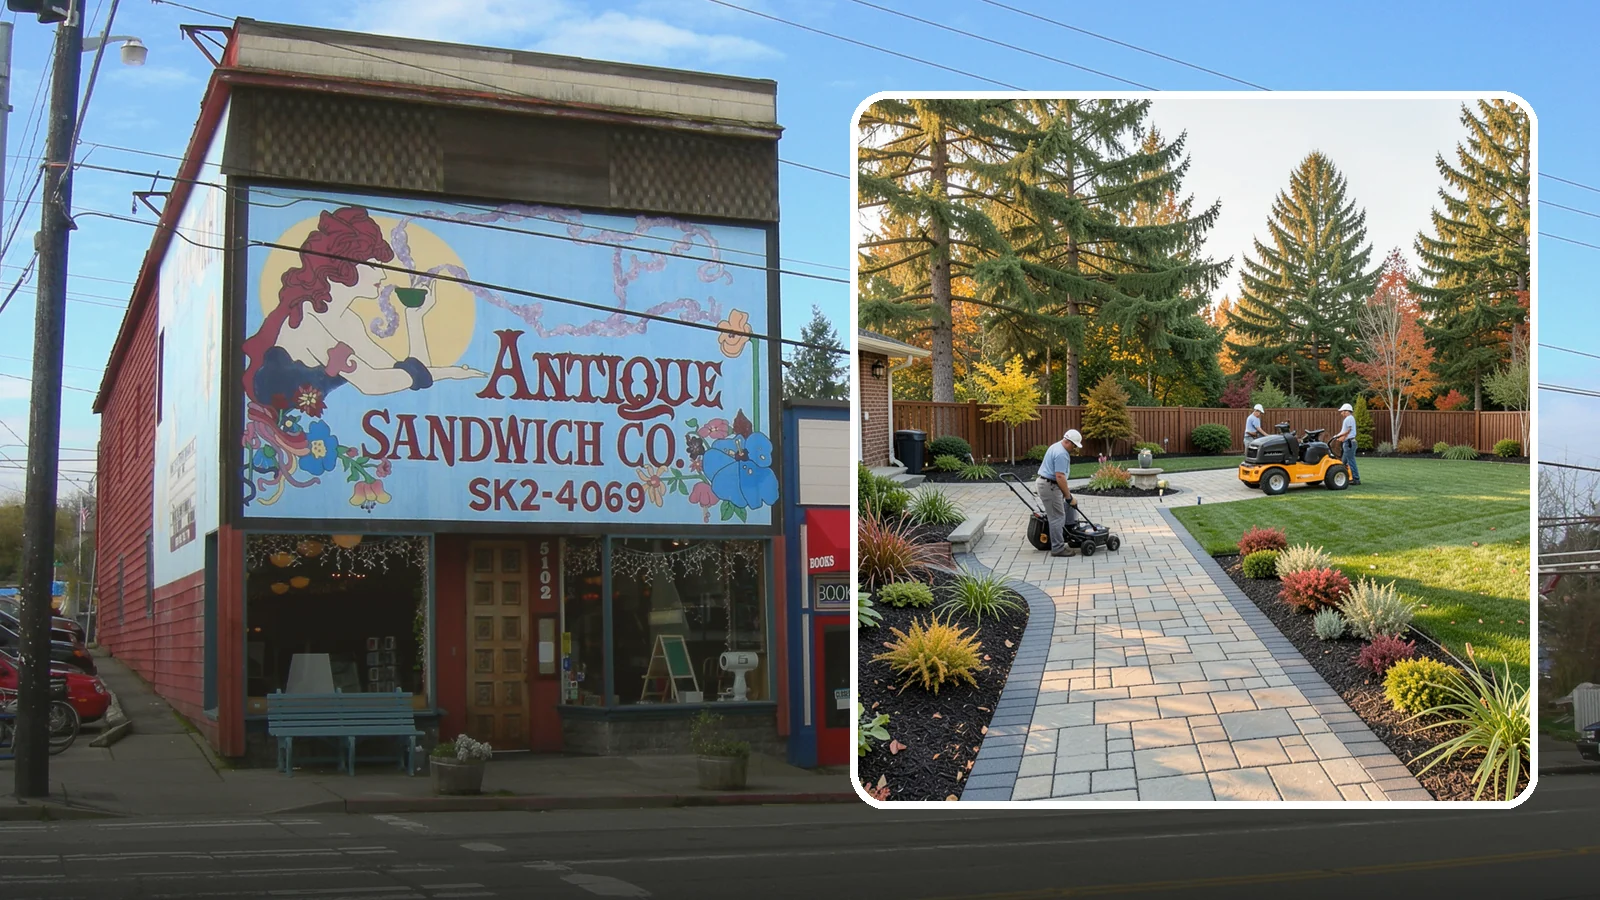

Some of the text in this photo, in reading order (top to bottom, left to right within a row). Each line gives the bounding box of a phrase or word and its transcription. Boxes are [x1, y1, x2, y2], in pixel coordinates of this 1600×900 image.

[475, 329, 723, 421] ANTIQUE
[361, 408, 685, 468] SANDWICH CO.
[469, 477, 645, 513] SK2-4069
[540, 542, 551, 599] 5102
[809, 555, 835, 569] BOOKS
